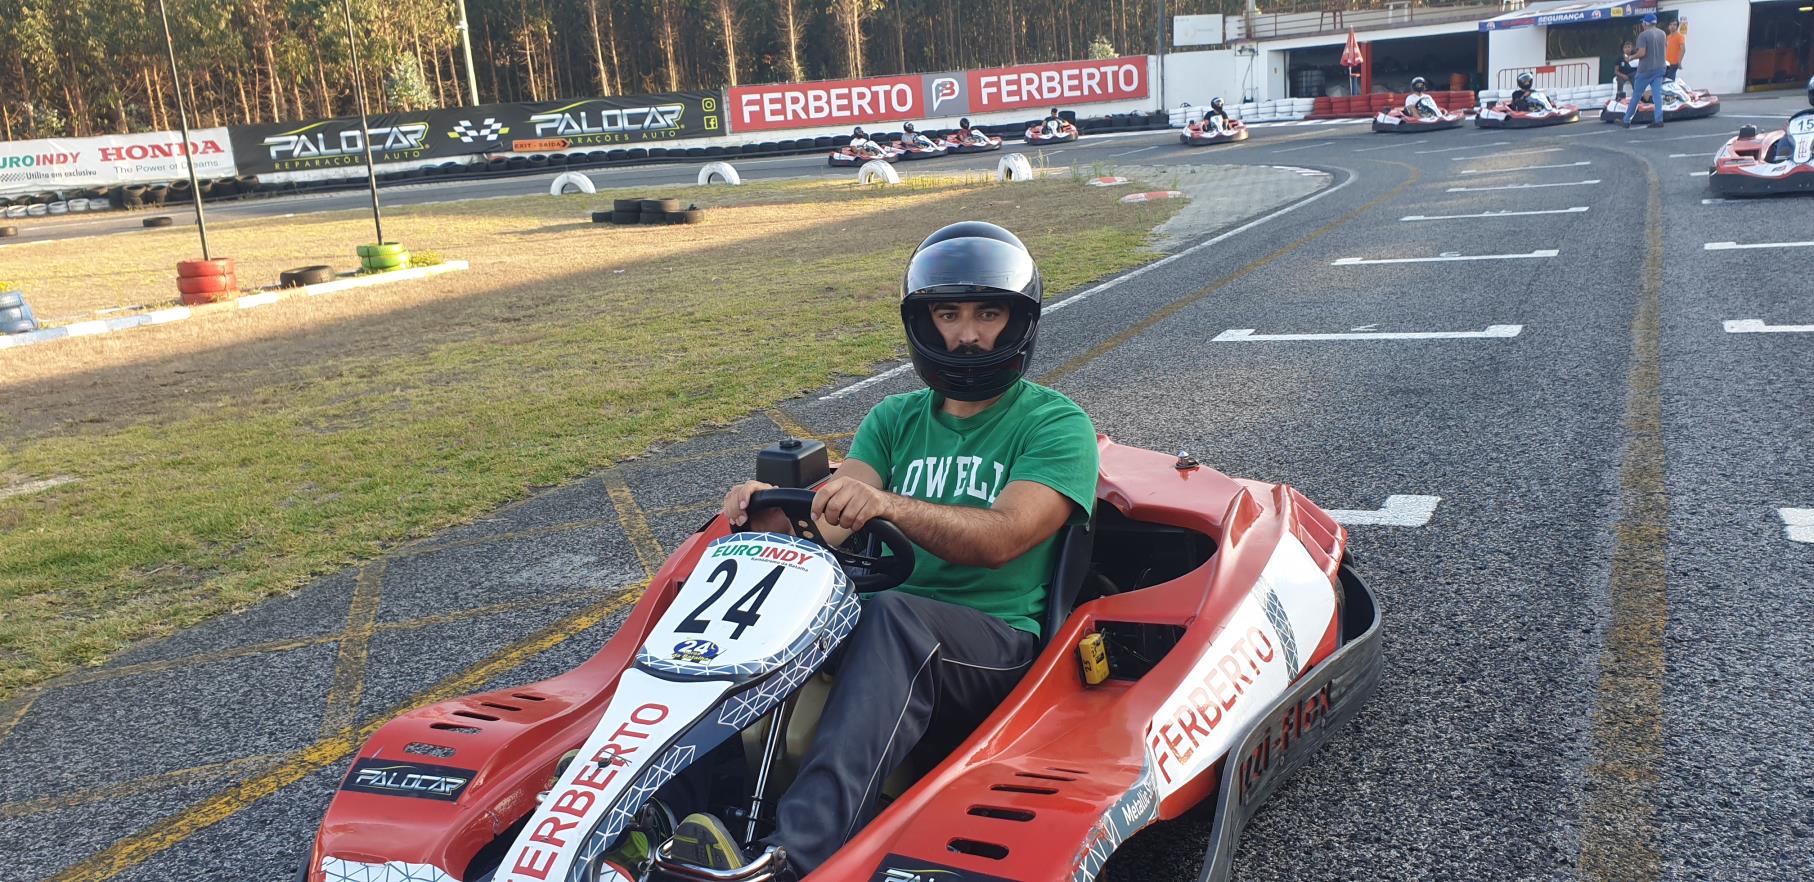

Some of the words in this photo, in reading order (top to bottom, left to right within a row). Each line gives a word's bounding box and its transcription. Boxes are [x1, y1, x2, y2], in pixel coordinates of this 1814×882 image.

[980, 63, 1139, 105] FERBERTO
[741, 83, 913, 123] FERBERTO
[530, 104, 684, 136] PALOCAR
[1798, 119, 1814, 131] 15
[263, 124, 428, 160] PALOCAR
[569, 133, 630, 145] ARAÇÕES
[642, 131, 676, 140] AUTO
[0, 151, 81, 169] UROINDY
[98, 139, 225, 162] HONDA
[384, 151, 420, 160] AUTO
[114, 166, 133, 174] The
[136, 164, 166, 173] Power
[181, 160, 219, 170] Deams
[711, 544, 813, 566] EUROINDY
[673, 558, 786, 641] 24
[678, 640, 711, 655] 24
[1151, 626, 1274, 784] FERBERTO
[356, 768, 467, 794] PALOCAR
[508, 703, 670, 882] ERBERTO
